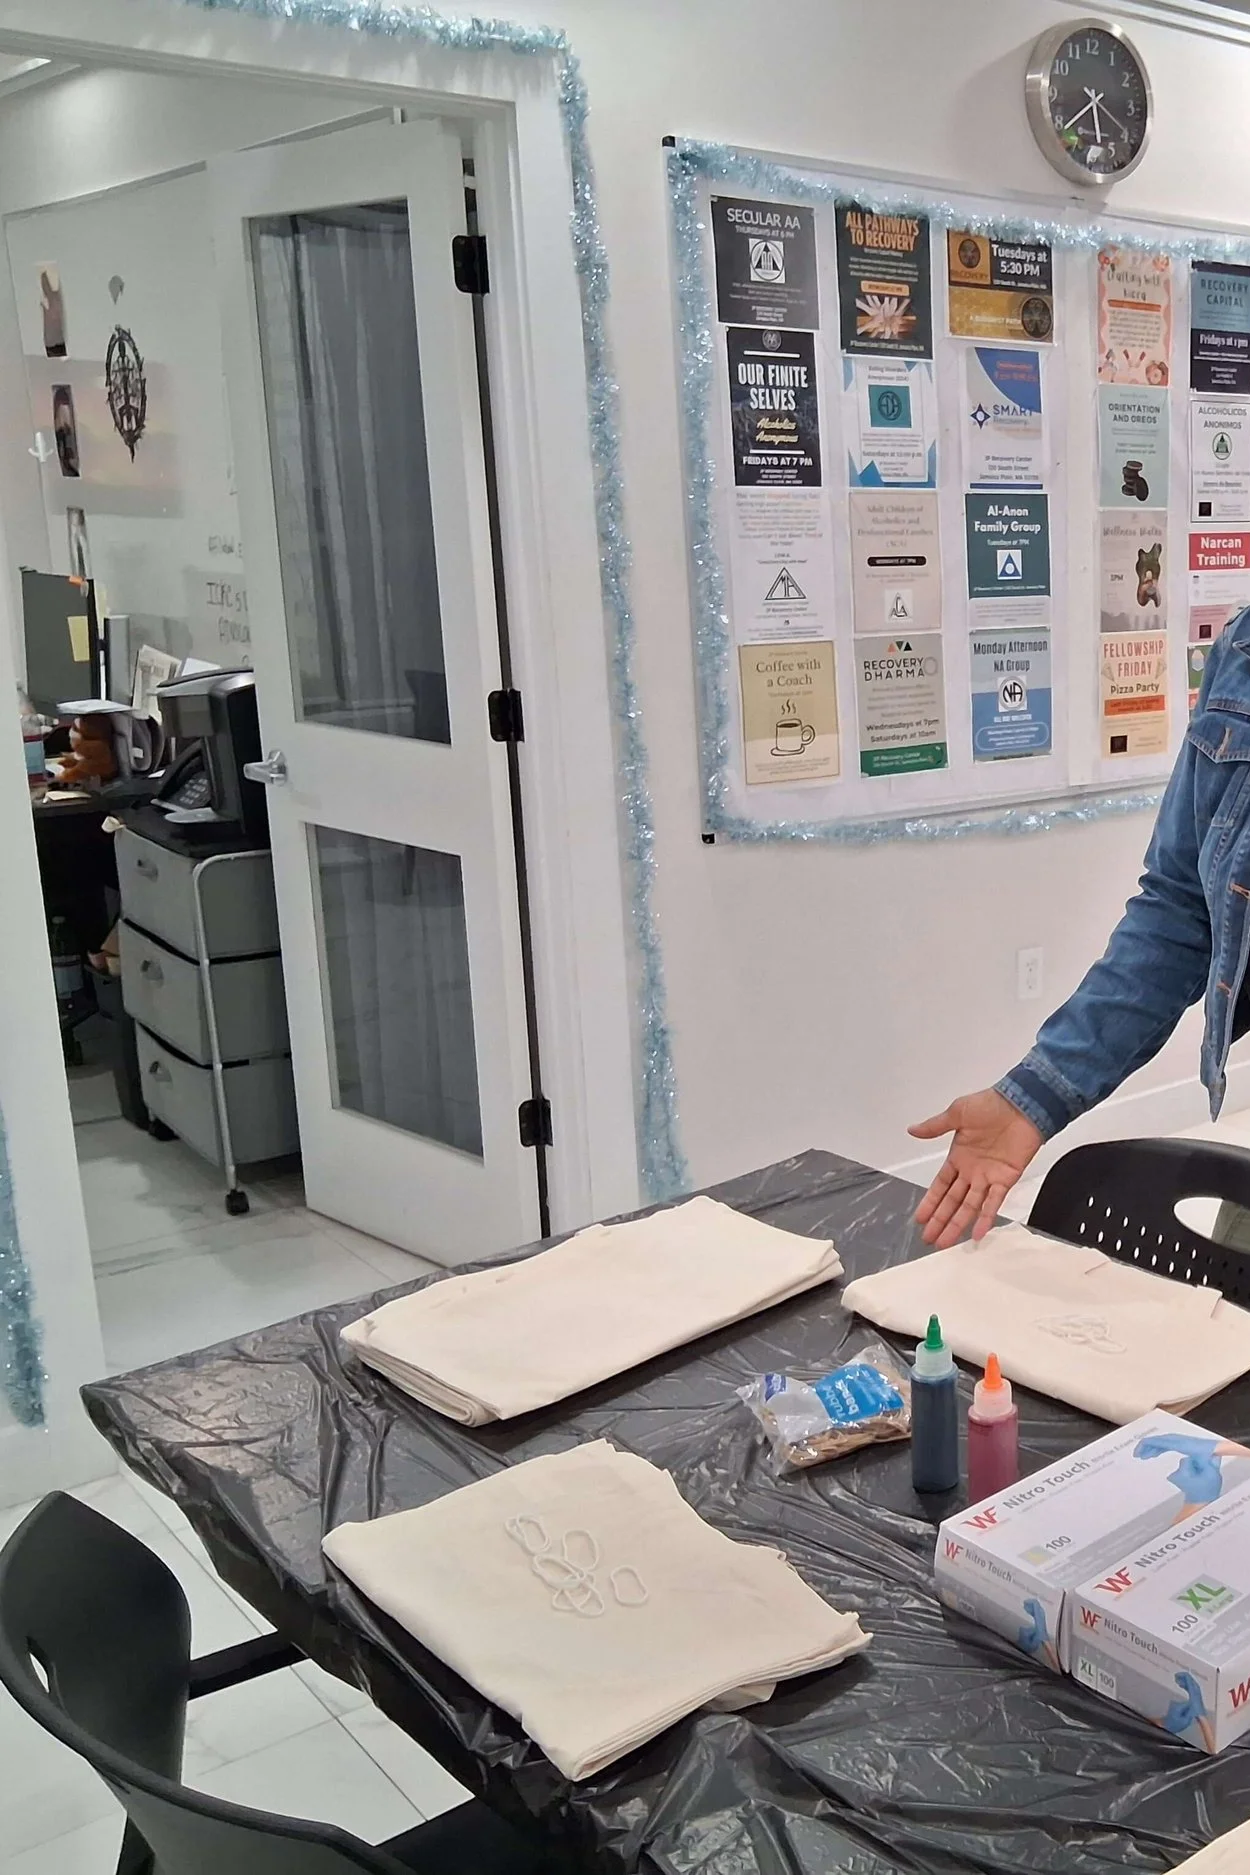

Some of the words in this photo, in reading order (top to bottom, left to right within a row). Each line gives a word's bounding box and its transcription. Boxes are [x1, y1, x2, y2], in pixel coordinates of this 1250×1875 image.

[1068, 42, 1081, 59] 11
[1086, 38, 1099, 54] 12
[1109, 52, 1115, 66] 1
[1053, 59, 1069, 75] 10
[1122, 72, 1129, 87] 2
[1127, 101, 1134, 116] 3
[1055, 115, 1063, 130] 8
[1108, 142, 1115, 158] 5
[727, 208, 781, 227] SECULAR
[785, 216, 800, 229] AA
[846, 212, 863, 228] ALL
[865, 213, 919, 236] PATHWAYS
[850, 229, 863, 245] TO
[866, 231, 915, 251] RECOVERY
[992, 244, 1036, 262] Tuesdays
[1037, 252, 1047, 262] at
[1001, 261, 1022, 274] 5:30
[1024, 265, 1040, 276] PM
[1201, 279, 1248, 294] RECOVERY
[1207, 295, 1243, 307] CAPITAL
[1200, 334, 1225, 347] Fridays
[738, 363, 764, 385] OUR
[768, 365, 808, 388] FINITE
[750, 388, 796, 411] SELVES
[1109, 403, 1160, 413] ORIENTATION
[1113, 415, 1129, 423] AND
[1131, 415, 1157, 424] OREOS
[743, 456, 778, 466] FRIDAYS
[780, 457, 790, 465] AT
[799, 458, 813, 466] PM
[987, 505, 1029, 516] Al-Anon
[974, 521, 1008, 535] Family
[1011, 521, 1041, 534] Group
[1201, 537, 1241, 548] Narcan
[1197, 553, 1245, 567] Training
[974, 642, 1007, 655] Monday
[1009, 641, 1048, 653] Afternoon
[1104, 640, 1164, 658] FELLOWSHIP
[756, 661, 794, 673] Coffee
[797, 659, 821, 671] with
[864, 657, 924, 670] RECOVERY
[994, 660, 1004, 672] NA
[1007, 659, 1030, 672] Group
[1118, 661, 1153, 677] FRIDAY
[767, 678, 773, 687] a
[777, 674, 812, 686] Coach
[864, 668, 925, 681] DHARMA
[1110, 685, 1134, 694] Pizza
[1136, 683, 1159, 692] Party
[866, 722, 914, 731] Wednesdays
[871, 734, 907, 743] Saturdays
[1003, 1485, 1045, 1509] Nitro
[1043, 1460, 1090, 1486] Touch
[960, 1507, 998, 1529] WF
[945, 1538, 963, 1559] WF
[1046, 1535, 1071, 1550] 100
[1134, 1543, 1177, 1568] Nitro
[1173, 1514, 1220, 1542] Touch
[966, 1549, 986, 1567] Nitro
[989, 1562, 1012, 1582] Touch
[1093, 1566, 1132, 1593] WF
[1177, 1583, 1227, 1611] XL
[1080, 1606, 1101, 1628] WF
[1172, 1614, 1198, 1633] 100
[1104, 1618, 1127, 1638] Nitro
[1131, 1632, 1158, 1654] Touch
[1080, 1660, 1094, 1677] XL
[1099, 1672, 1114, 1689] 100
